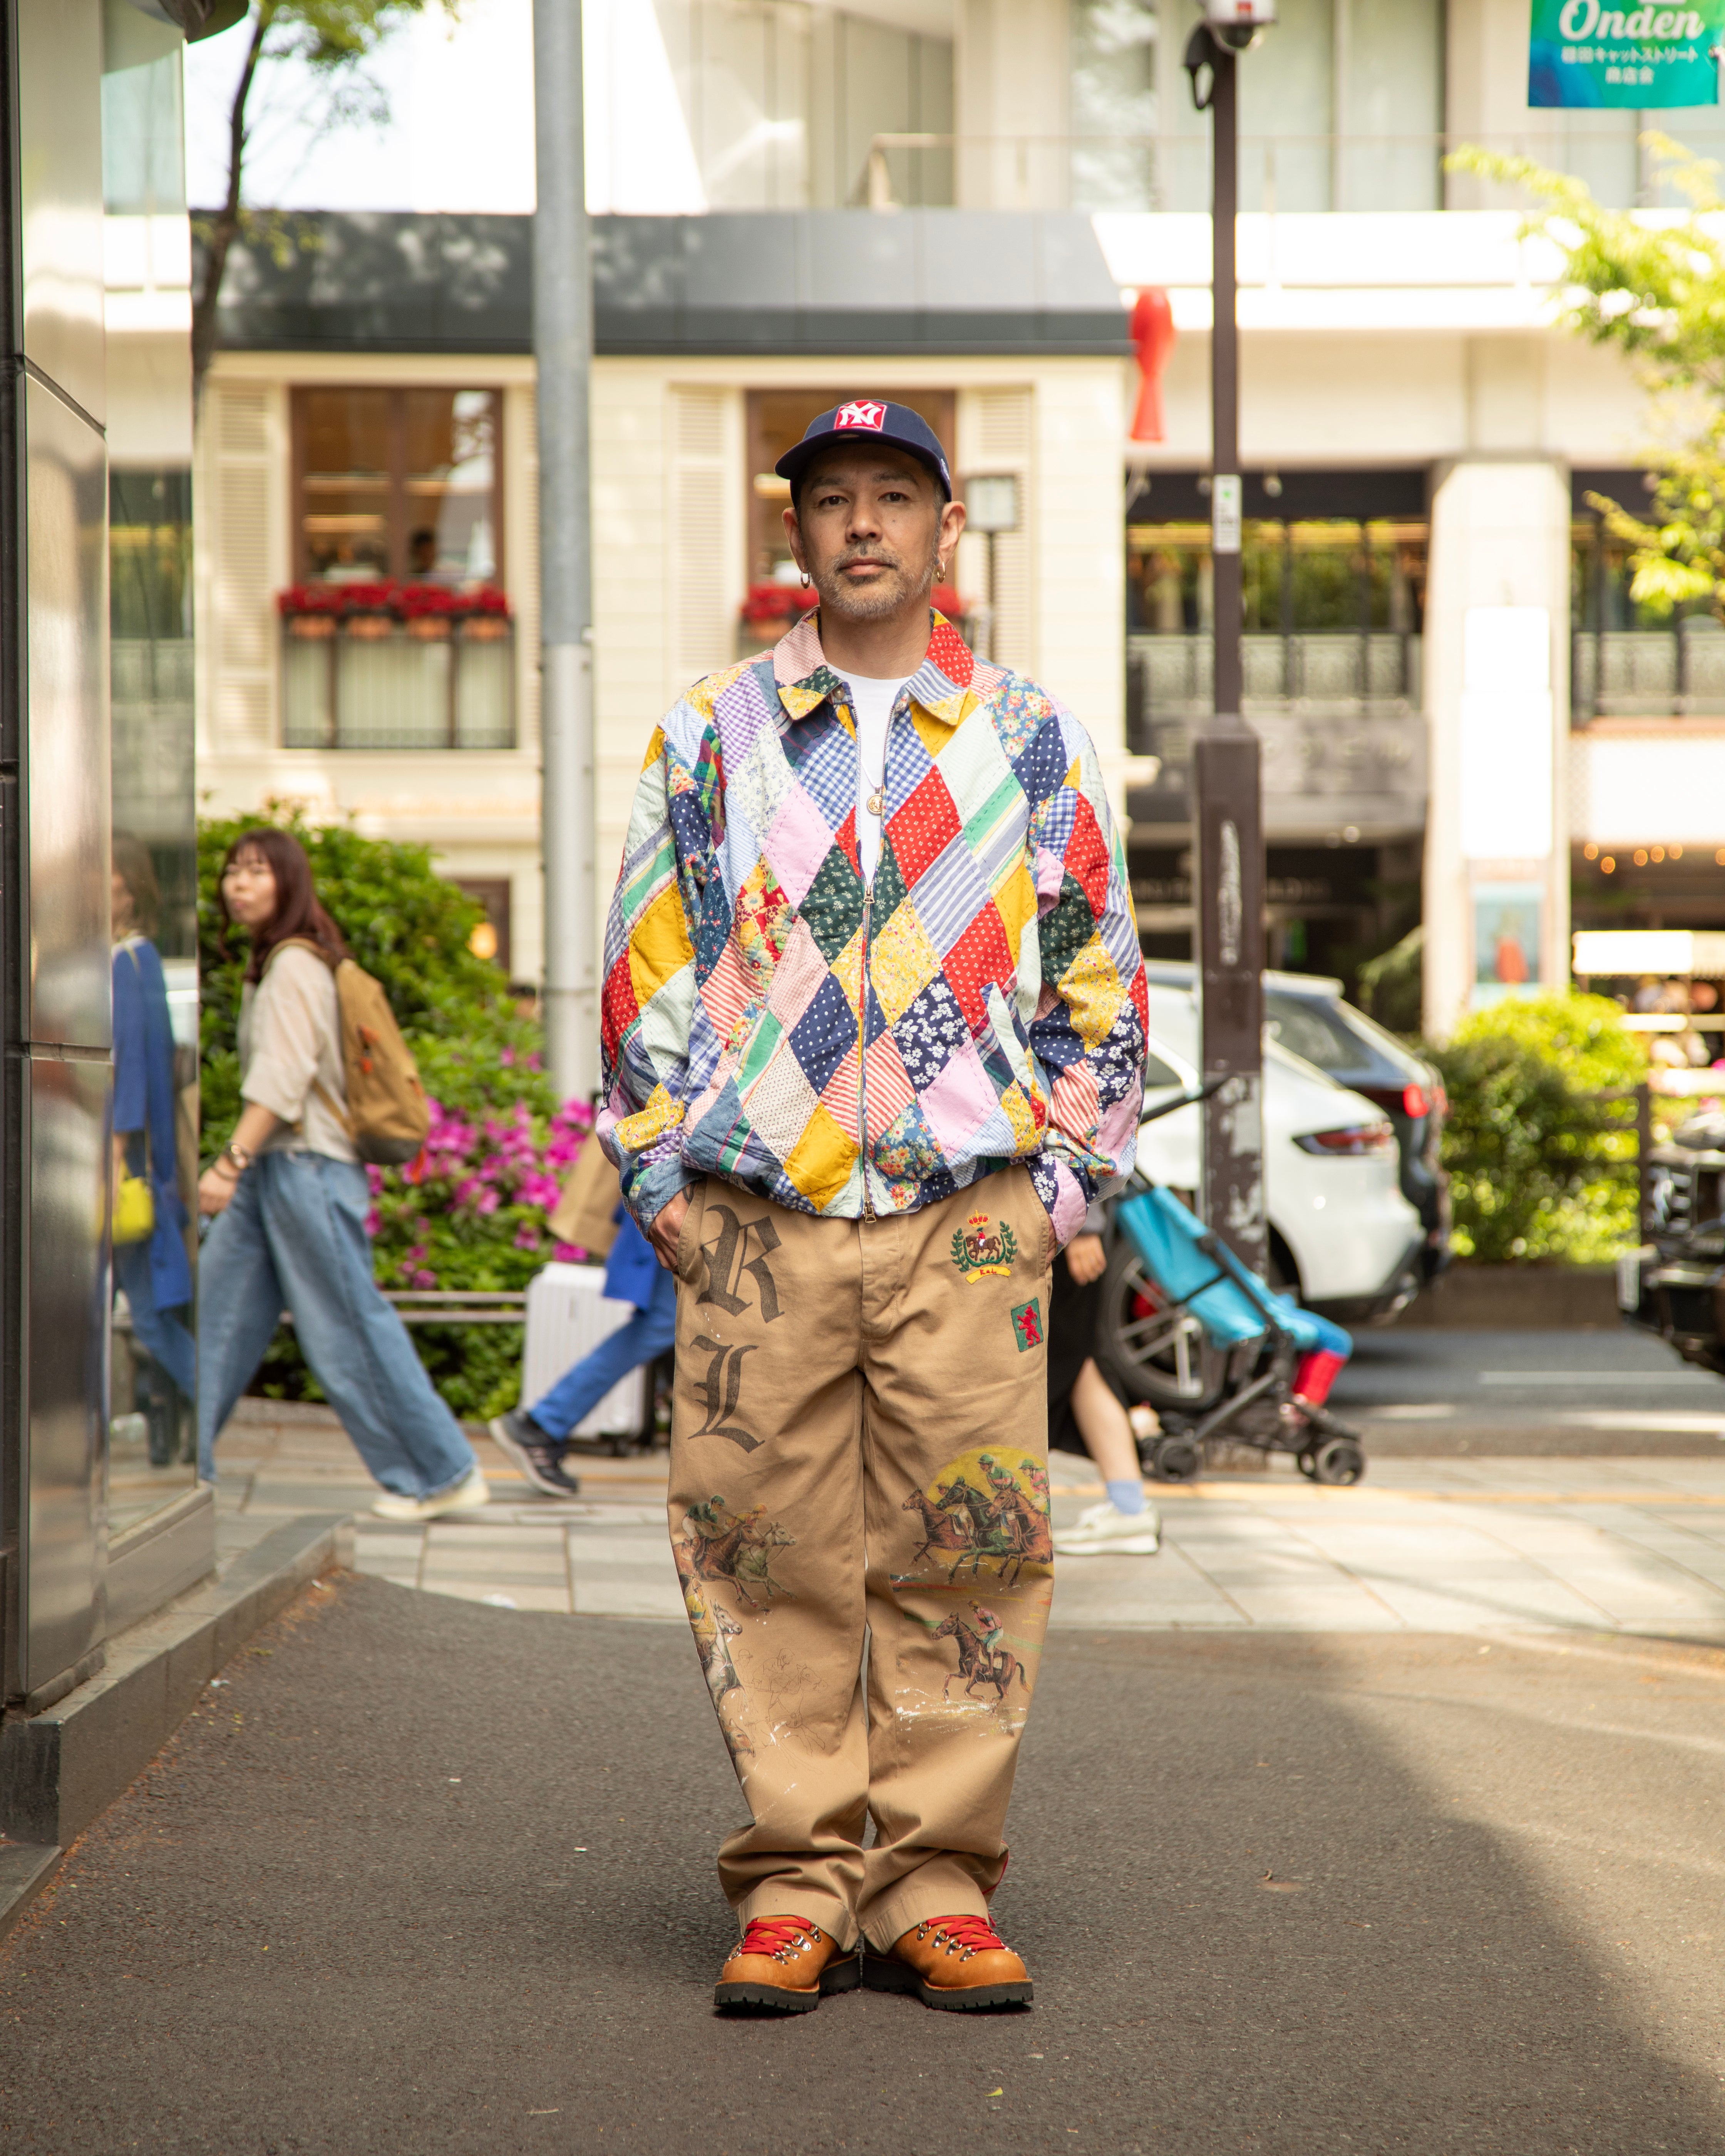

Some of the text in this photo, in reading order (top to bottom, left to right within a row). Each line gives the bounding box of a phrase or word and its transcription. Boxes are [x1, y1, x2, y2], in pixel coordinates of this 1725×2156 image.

[1559, 0, 1705, 41] Onden
[695, 1204, 785, 1324] R
[688, 1334, 765, 1453] L
